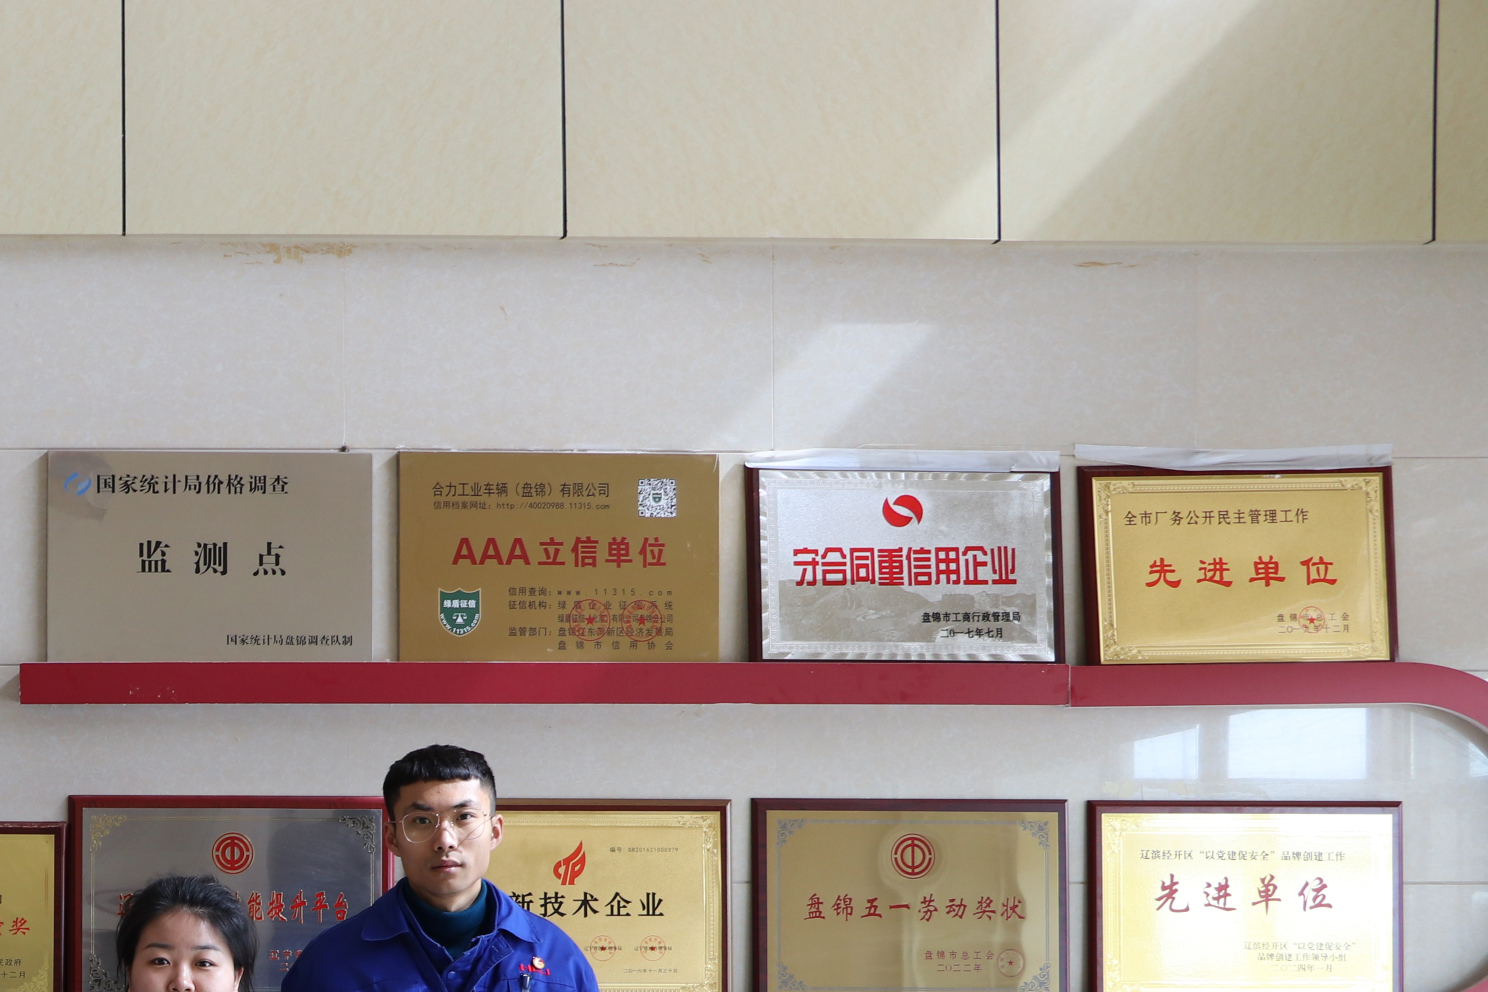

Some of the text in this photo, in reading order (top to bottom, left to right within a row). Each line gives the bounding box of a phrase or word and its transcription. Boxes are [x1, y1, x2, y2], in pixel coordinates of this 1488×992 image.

[96, 474, 289, 495] 国家统计局价格调查
[432, 482, 611, 498] 合力工业车辆（盘锦）有限公司
[1123, 508, 1310, 527] 全市厂务公开民主管理工作
[136, 540, 287, 577] 监测点
[451, 536, 667, 568] AAA立信单位
[792, 545, 1018, 587] 守合同重信用企业
[1145, 555, 1338, 588] 先进单位
[443, 599, 477, 608] 绿盾征信
[921, 612, 1021, 623] 盘锦市工商行政管理局
[226, 634, 354, 647] 国家统计局盘锦调查队制
[557, 640, 674, 651] 盘锦市信用协会
[1154, 873, 1334, 916] 先进单位
[235, 888, 349, 924] 能提升平台
[804, 893, 1026, 922] 盘锦五一劳动奖状
[924, 950, 995, 960] 盘锦市总工会
